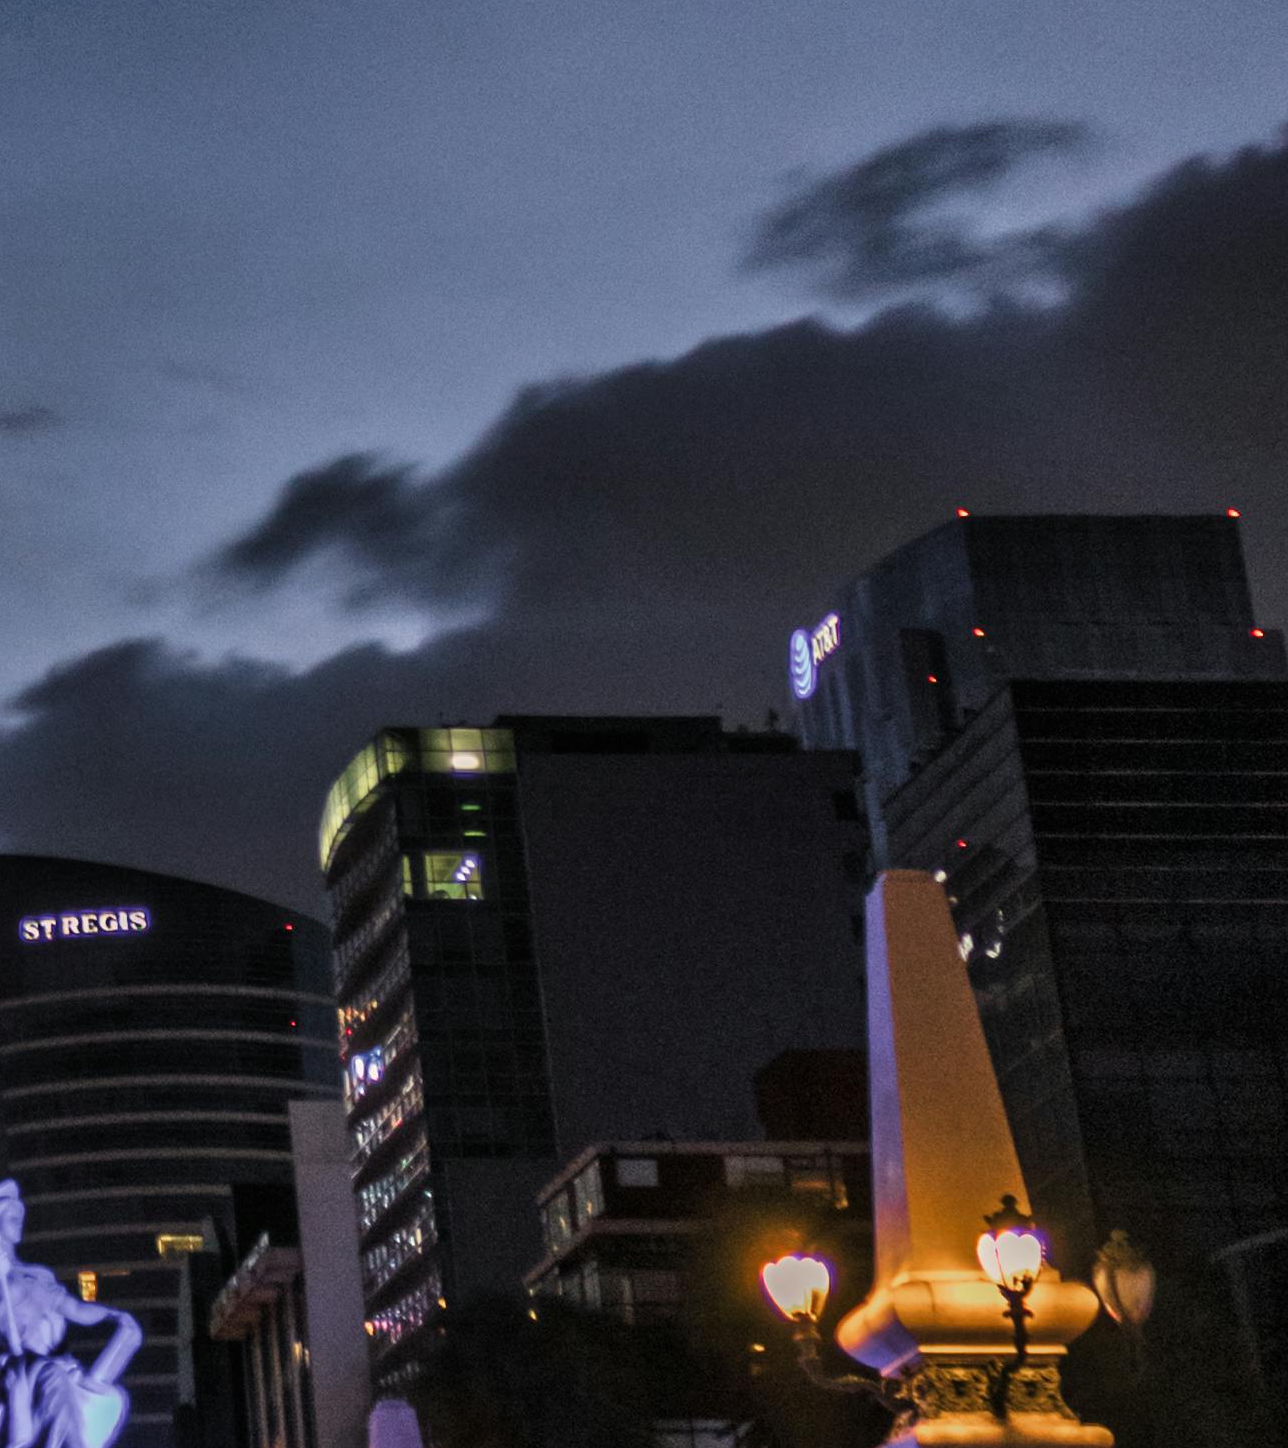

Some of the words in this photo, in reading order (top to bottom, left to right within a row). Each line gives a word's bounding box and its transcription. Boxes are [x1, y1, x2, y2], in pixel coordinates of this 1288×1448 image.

[811, 614, 838, 665] AT&T
[23, 919, 56, 940] ST
[62, 910, 146, 935] REGIS
